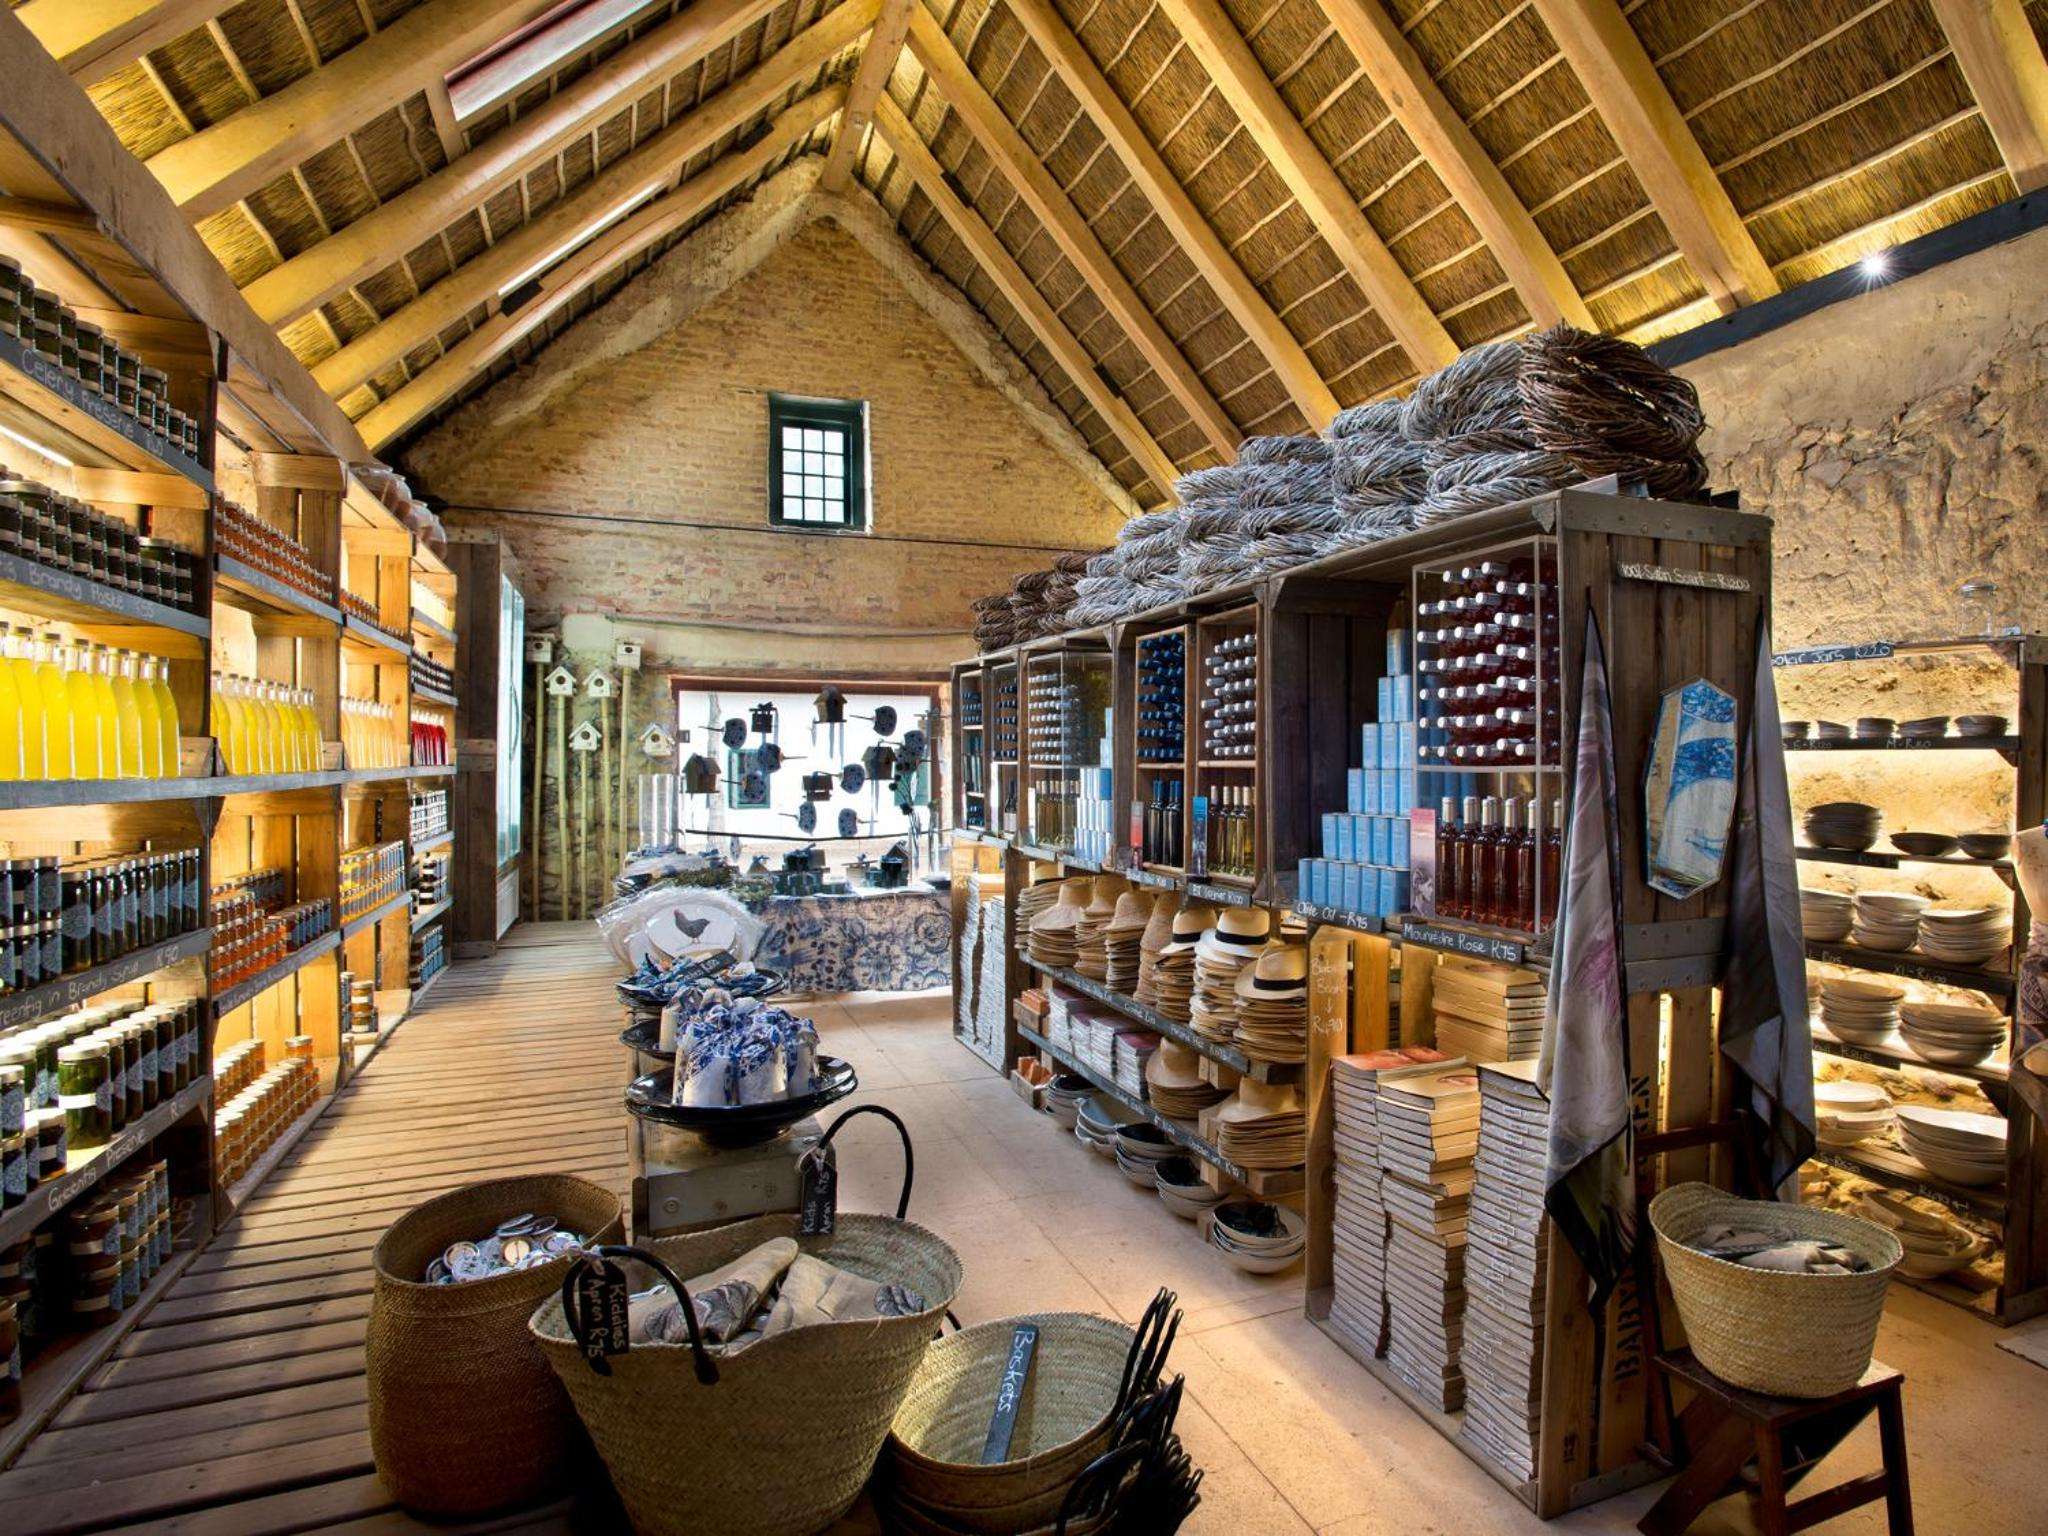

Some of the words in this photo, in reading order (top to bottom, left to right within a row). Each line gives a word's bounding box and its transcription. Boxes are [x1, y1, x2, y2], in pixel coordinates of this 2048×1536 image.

[1772, 651, 1804, 666] olar
[1812, 649, 1845, 664] Jars
[1296, 901, 1318, 918] Olive
[1322, 906, 1336, 921] Oil
[609, 1283, 629, 1351] Kiddies
[998, 1330, 1036, 1413] Baskets
